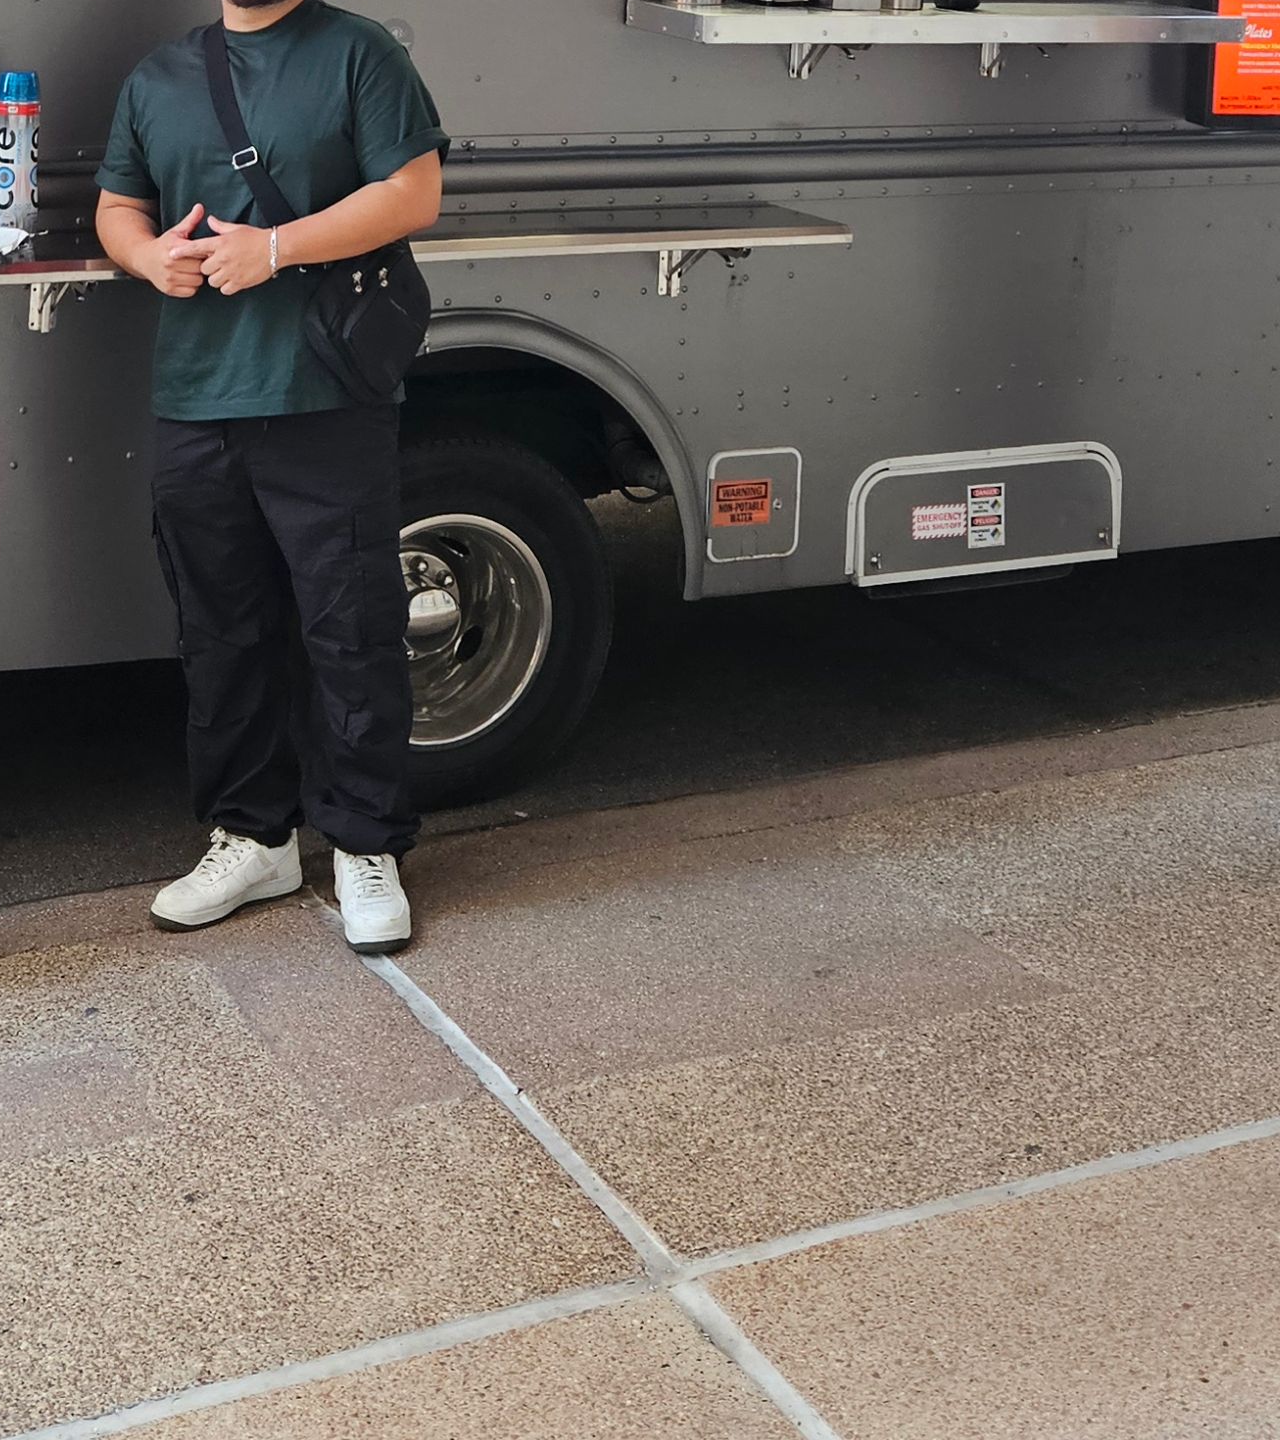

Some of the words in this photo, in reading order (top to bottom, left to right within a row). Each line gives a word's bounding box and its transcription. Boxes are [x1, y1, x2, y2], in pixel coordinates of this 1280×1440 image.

[721, 485, 763, 498] WARNING
[730, 512, 753, 523] WATER
[916, 512, 962, 523] EMERGENCY
